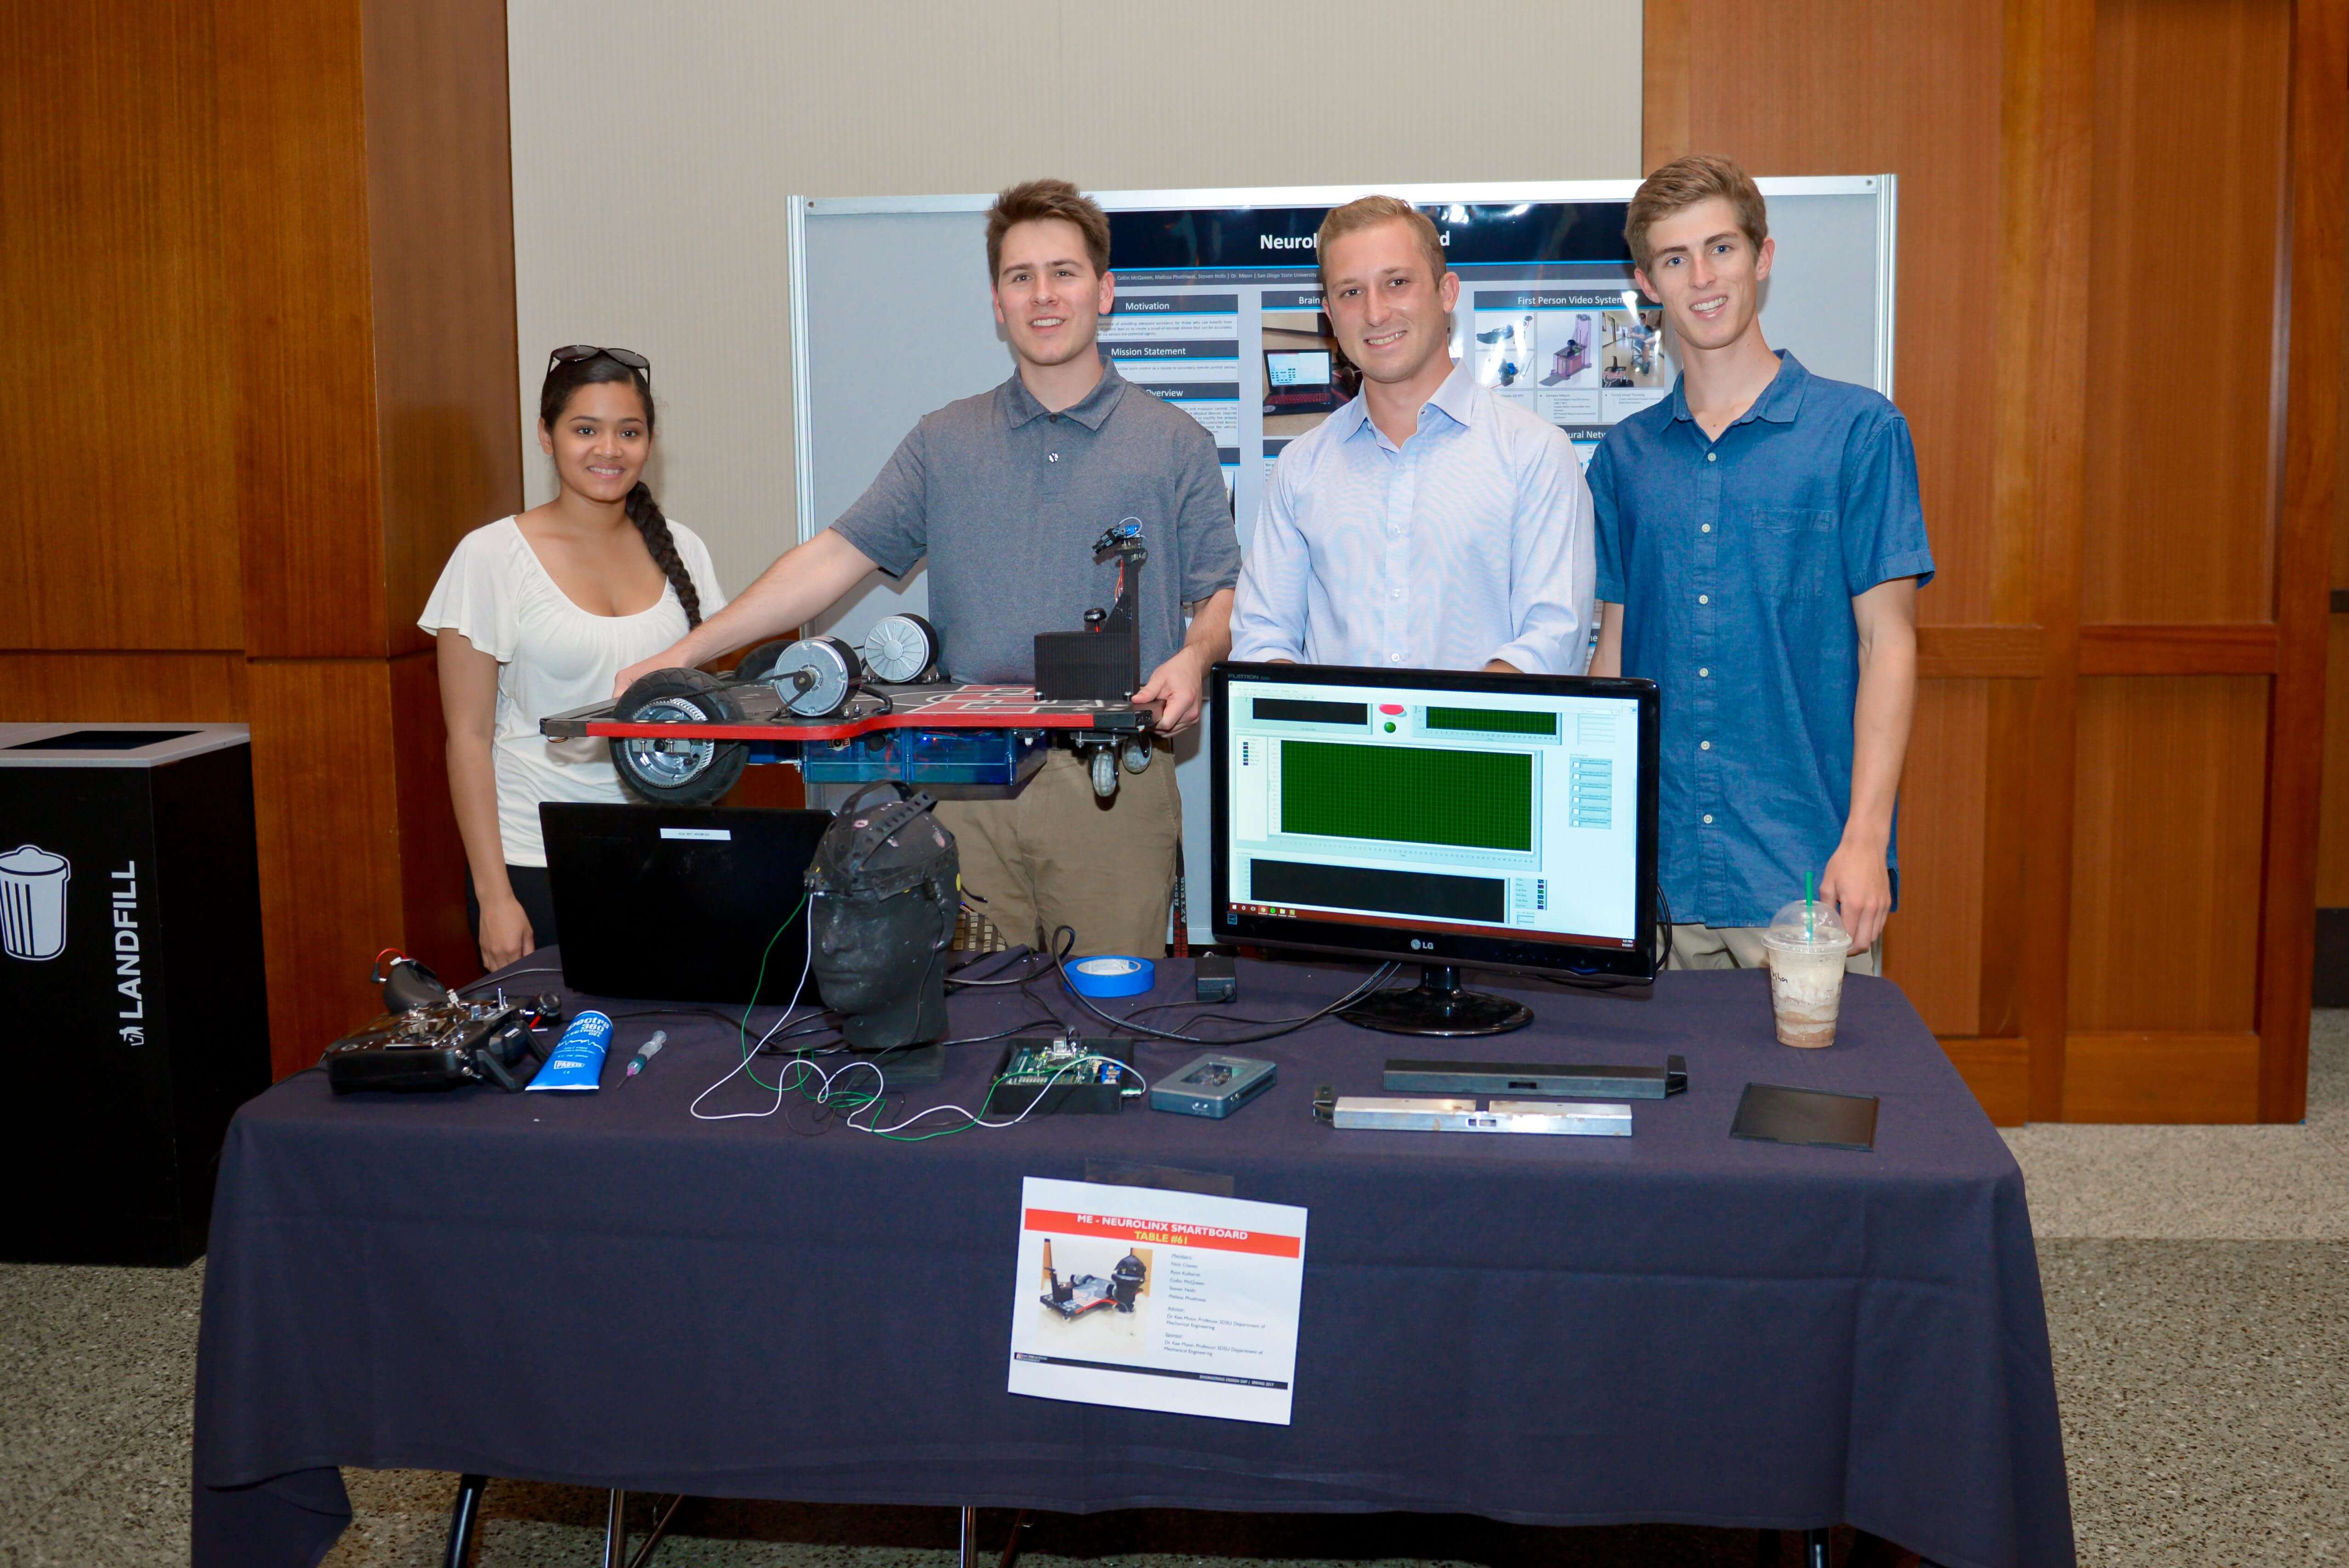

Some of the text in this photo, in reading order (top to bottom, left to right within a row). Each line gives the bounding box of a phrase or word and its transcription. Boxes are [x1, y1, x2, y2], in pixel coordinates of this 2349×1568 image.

[1261, 233, 1318, 249] Neurol
[1569, 296, 1593, 304] Video
[1126, 302, 1169, 310] Motivation
[1111, 347, 1186, 356] Mission Statement
[1568, 430, 1584, 439] ural
[111, 860, 143, 1019] LANDFILL
[1422, 941, 1434, 950] LG
[1077, 1214, 1093, 1224] ME
[1102, 1216, 1168, 1232] NEUROLINX
[1171, 1224, 1248, 1240] SMARTBOARD
[1134, 1230, 1188, 1245] TABLE #61
